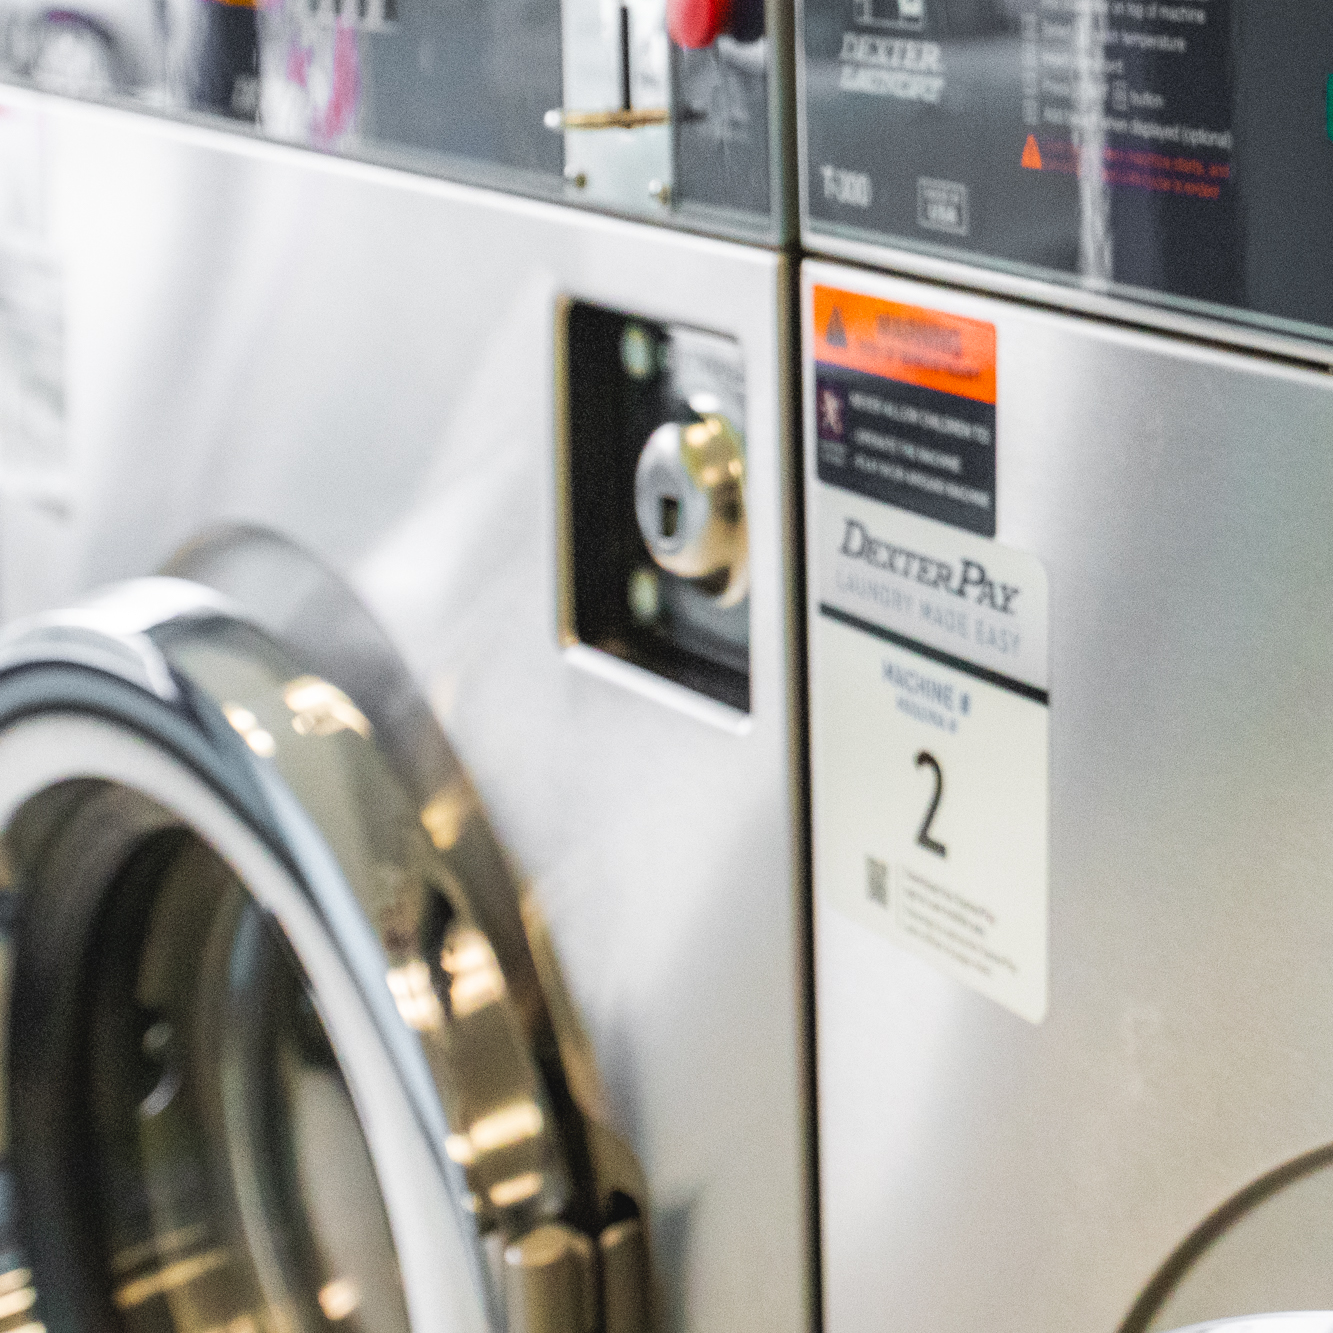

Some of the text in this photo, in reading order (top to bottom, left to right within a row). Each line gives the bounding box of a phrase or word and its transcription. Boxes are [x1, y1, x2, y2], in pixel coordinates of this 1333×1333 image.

[840, 31, 945, 72] DEXTER
[835, 566, 1021, 657] LAUNDRY MADE EASY
[881, 659, 955, 712] MACHINE
[914, 747, 948, 860] 2
